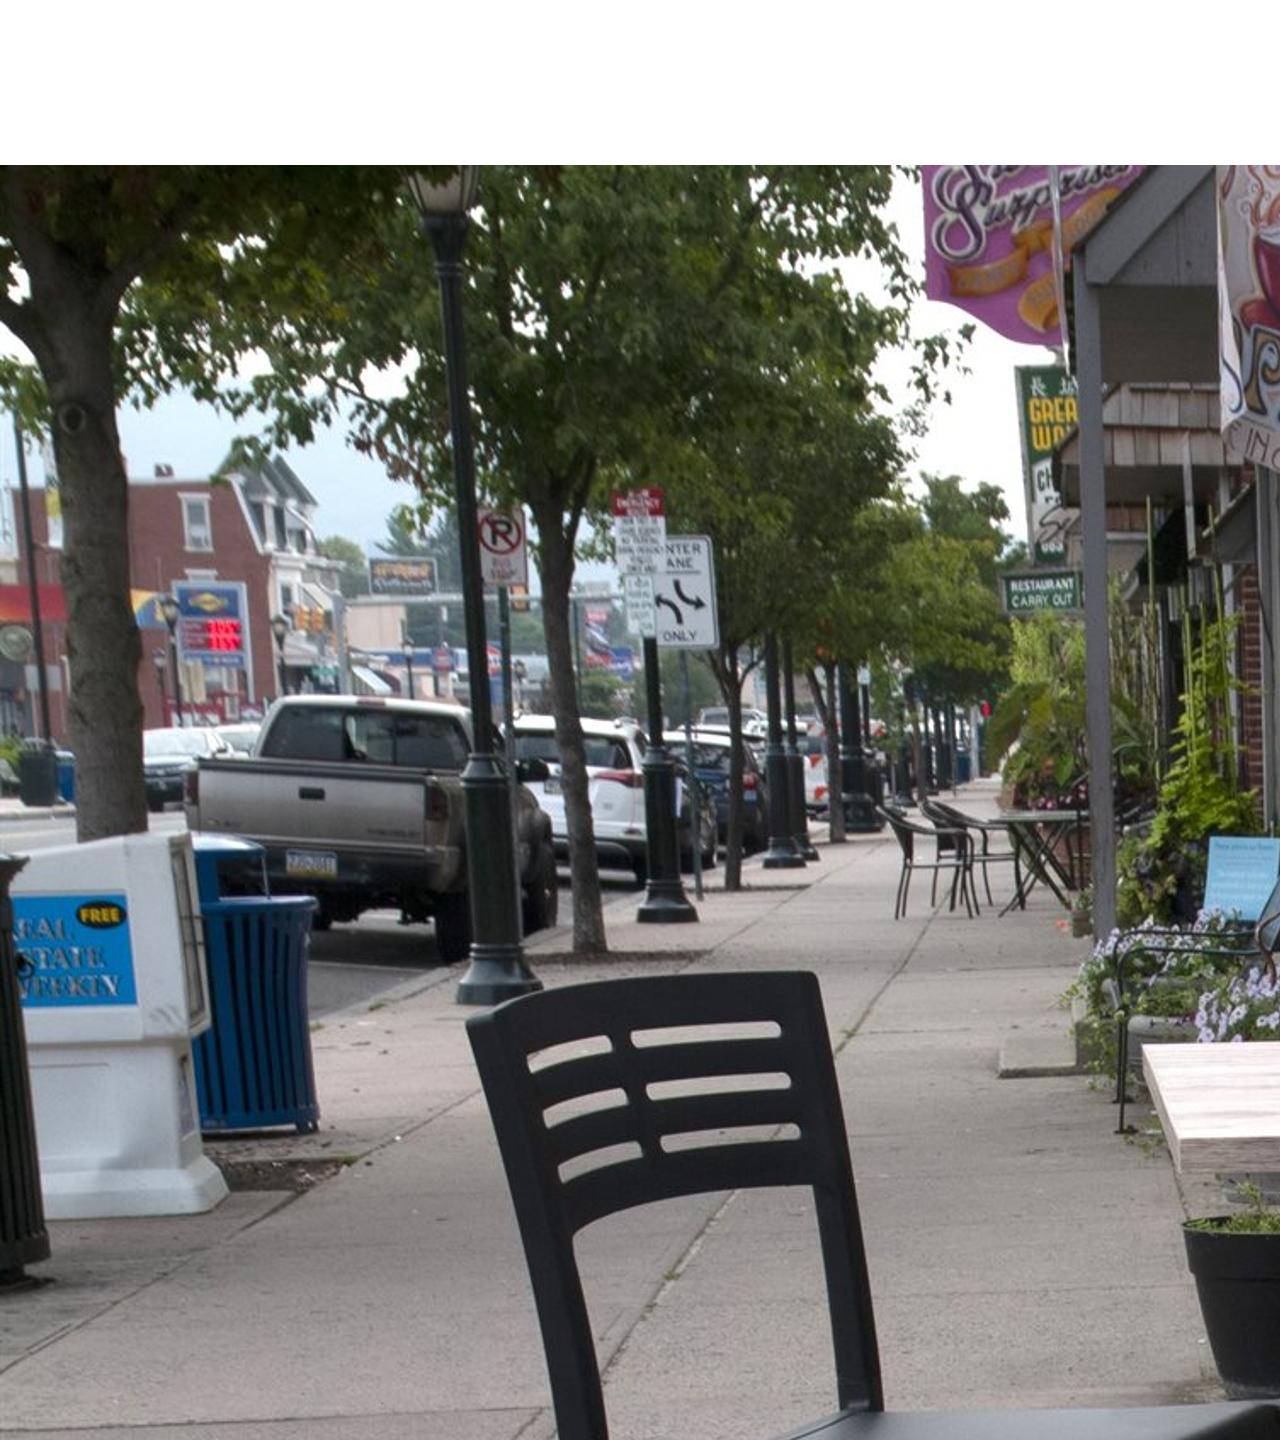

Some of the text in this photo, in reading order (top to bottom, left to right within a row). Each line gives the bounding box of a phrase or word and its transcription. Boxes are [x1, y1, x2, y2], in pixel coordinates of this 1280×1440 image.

[1028, 396, 1078, 423] GREA
[665, 543, 701, 555] NTER
[666, 557, 693, 569] ANE
[1010, 578, 1074, 592] RESTAURANT
[1011, 593, 1073, 608] CARRY OUT
[663, 630, 697, 642] ONLY
[80, 907, 120, 923] FREE
[13, 917, 75, 941] EAL
